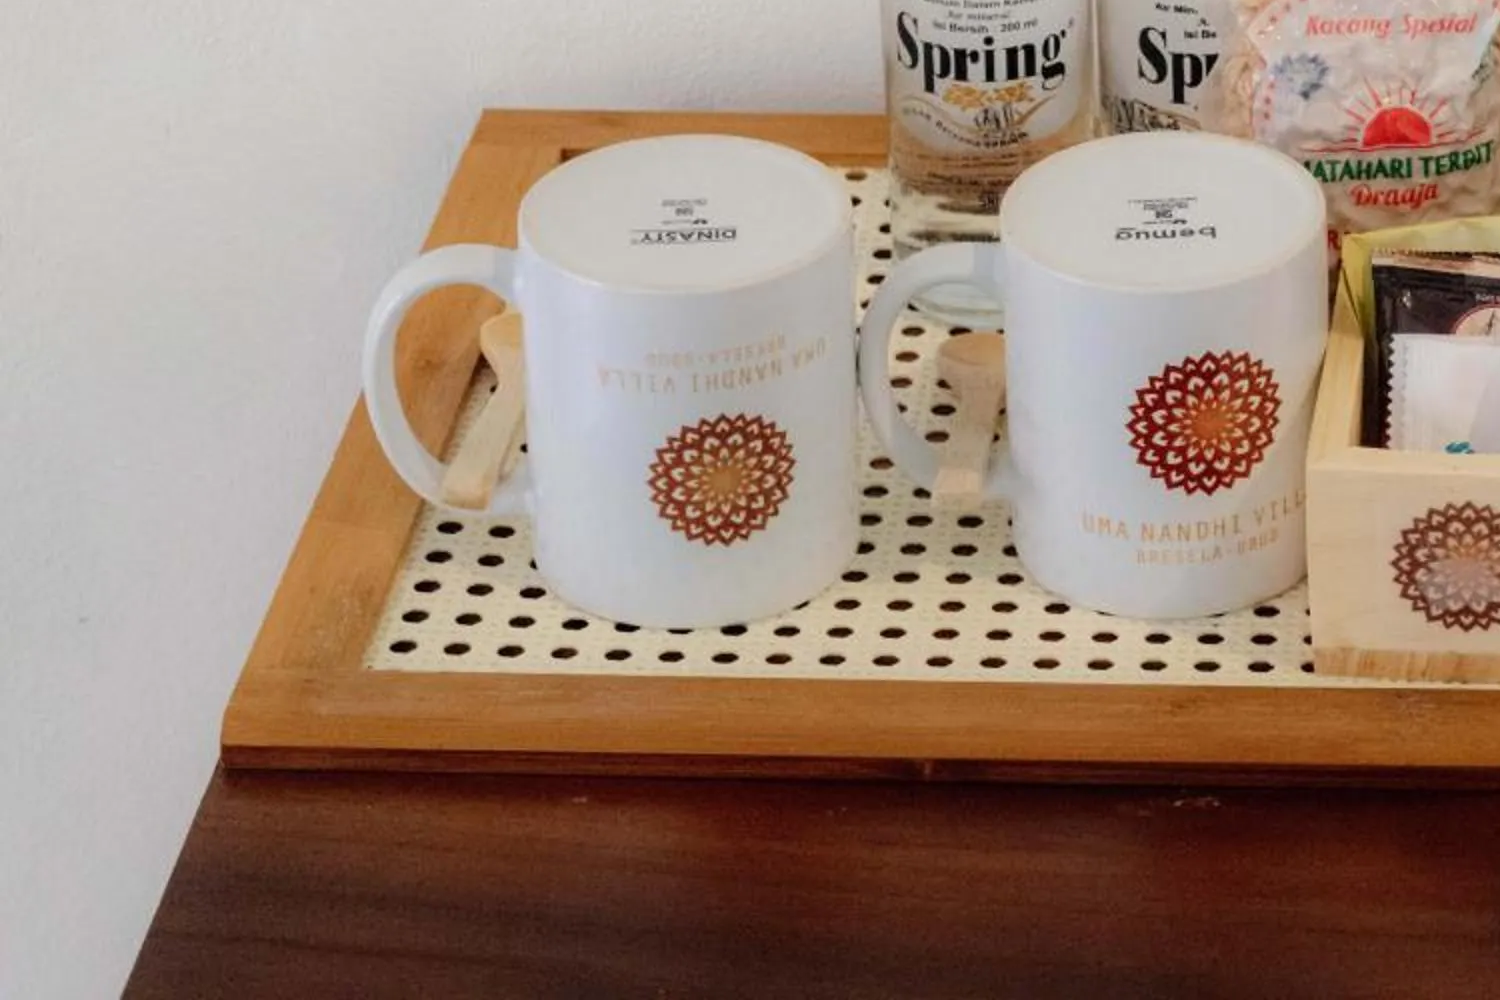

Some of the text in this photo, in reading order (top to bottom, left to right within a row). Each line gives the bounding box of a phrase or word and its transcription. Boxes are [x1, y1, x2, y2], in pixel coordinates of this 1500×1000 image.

[1305, 12, 1479, 42] Kacang Spesial
[897, 11, 1068, 94] Spring
[641, 227, 738, 244] DINASTY
[1114, 225, 1218, 242] bemug
[1082, 491, 1309, 542] UMA NANDHI VILL
